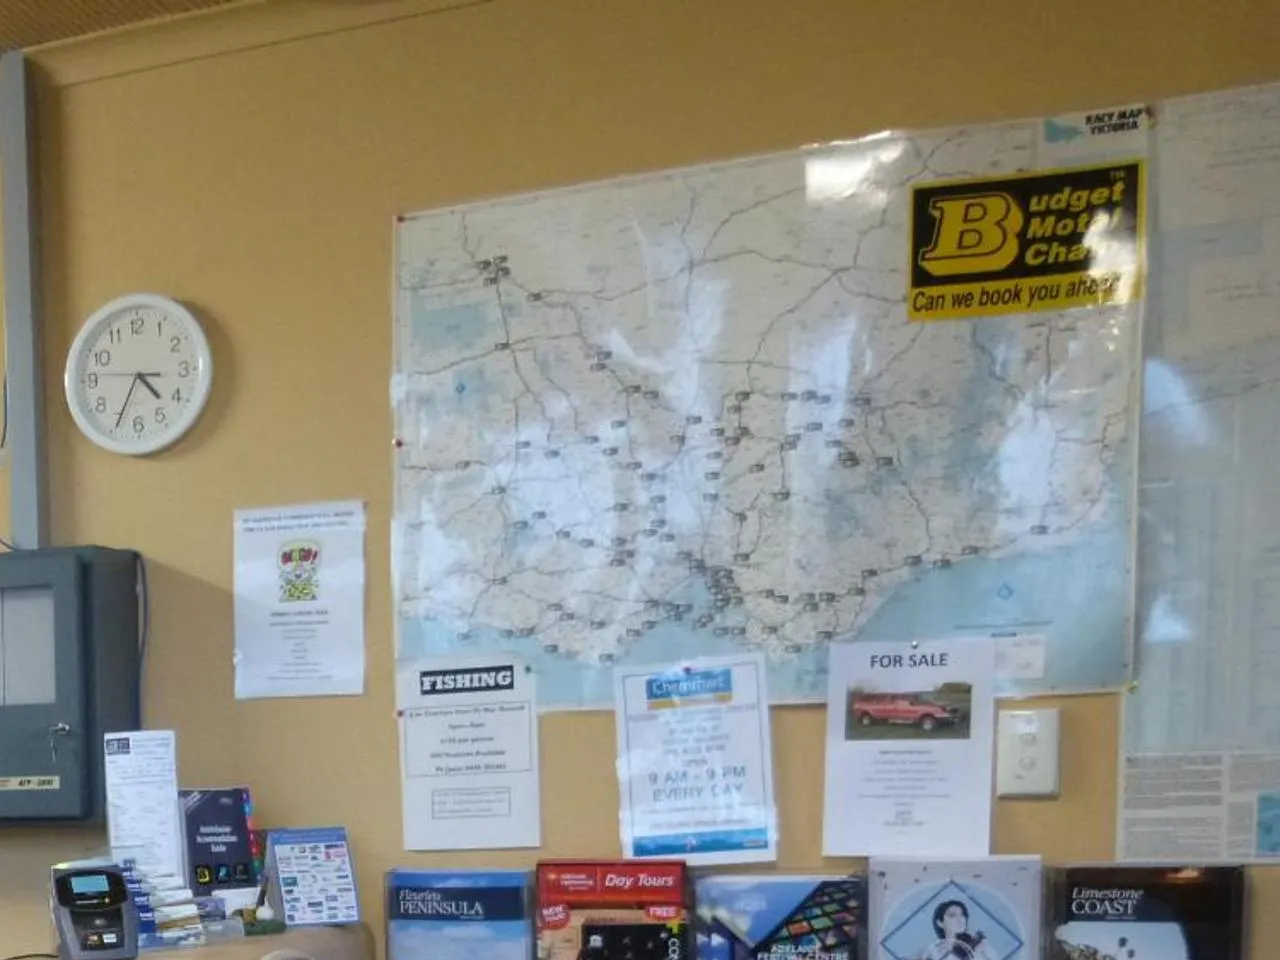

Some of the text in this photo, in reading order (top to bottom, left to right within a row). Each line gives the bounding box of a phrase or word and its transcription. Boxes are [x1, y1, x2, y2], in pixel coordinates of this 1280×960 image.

[912, 290, 946, 313] Can
[950, 289, 975, 309] we
[978, 284, 1023, 308] book
[1026, 279, 1062, 306] you
[109, 328, 122, 345] 11
[130, 318, 145, 337] 12
[169, 335, 181, 354] 2
[94, 349, 112, 368] 10
[178, 360, 190, 379] 3
[87, 372, 99, 390] 9
[95, 396, 107, 414] 8
[171, 387, 183, 406] 4
[154, 406, 167, 424] 5
[132, 415, 145, 434] 6
[870, 652, 950, 669] FOR SALE
[421, 670, 512, 691] FISHING
[665, 769, 689, 785] AM
[722, 765, 746, 779] PM
[652, 785, 704, 802] EVERY
[604, 873, 635, 888] Day
[637, 873, 674, 887] Tours
[1072, 887, 1145, 900] Limestone
[399, 900, 484, 915] PENINSULA
[648, 905, 678, 917] FREE
[1071, 899, 1136, 915] COAST
